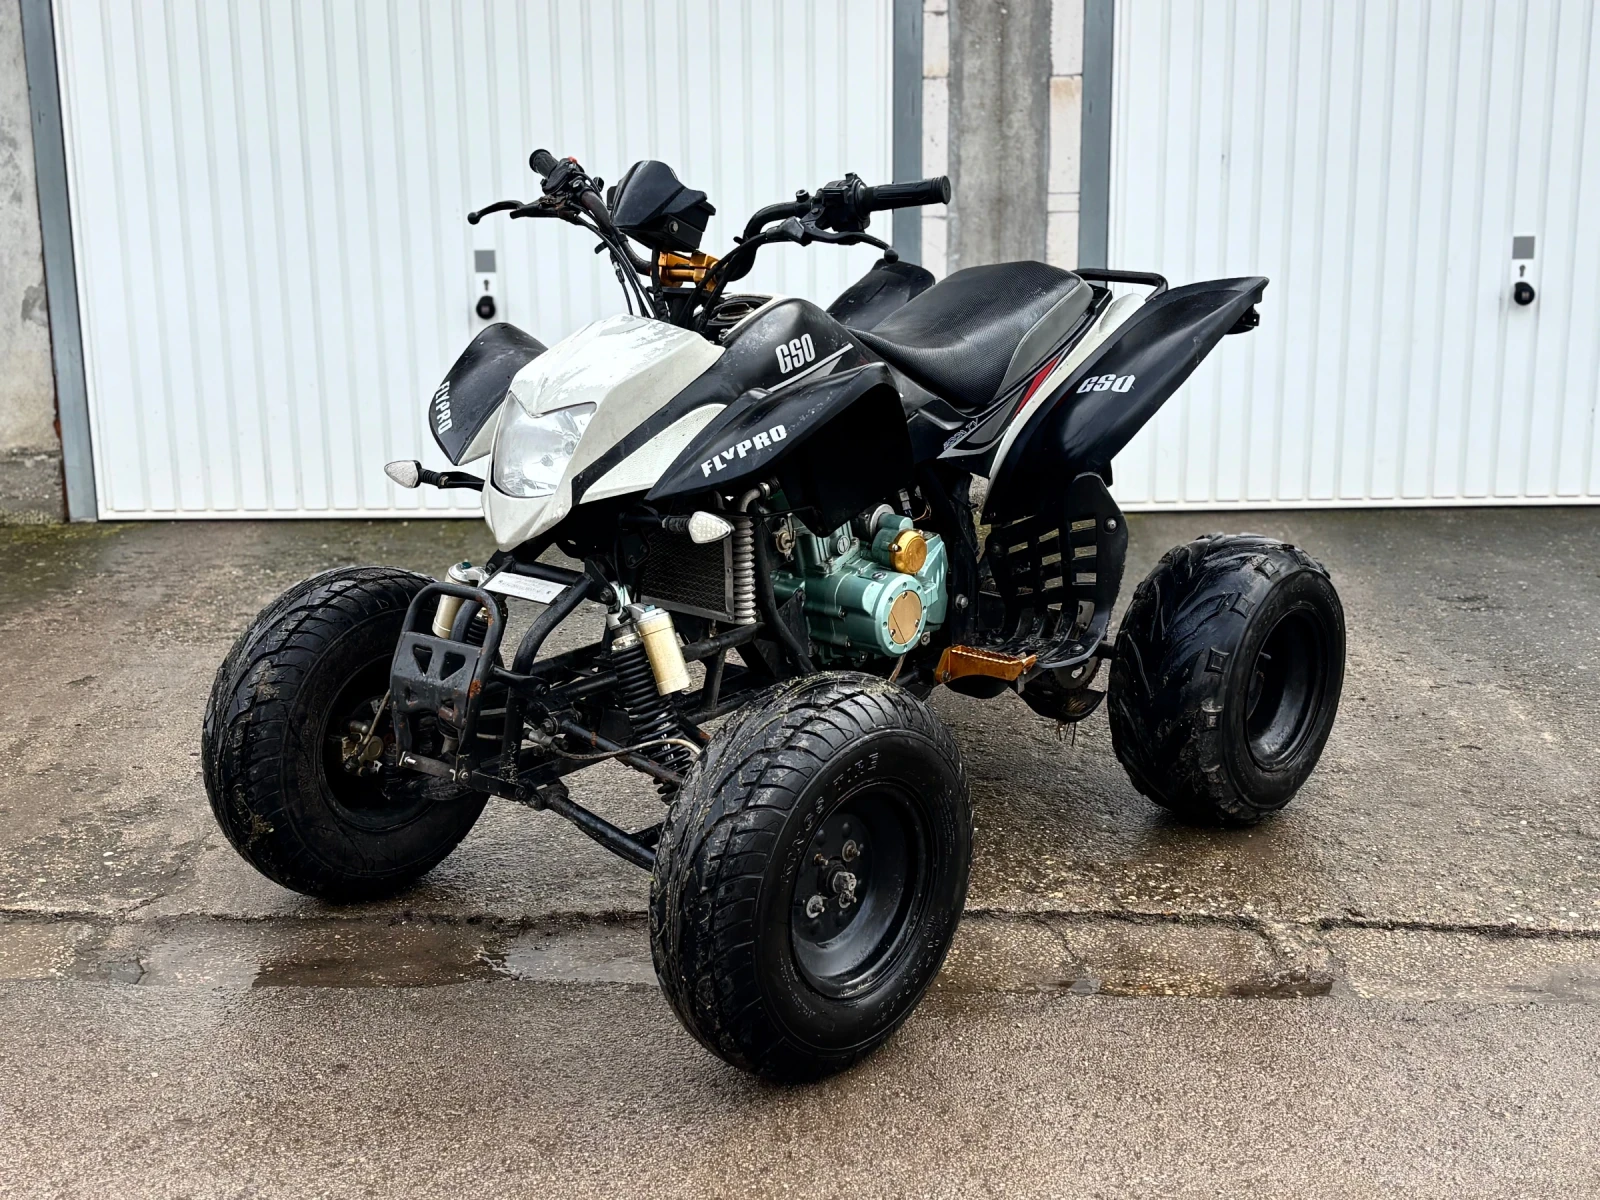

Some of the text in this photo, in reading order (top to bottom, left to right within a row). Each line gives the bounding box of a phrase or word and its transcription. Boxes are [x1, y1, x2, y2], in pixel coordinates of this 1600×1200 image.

[435, 381, 453, 435] FLYPRO
[700, 424, 788, 478] FLYPRO
[833, 752, 879, 791] TIRE
